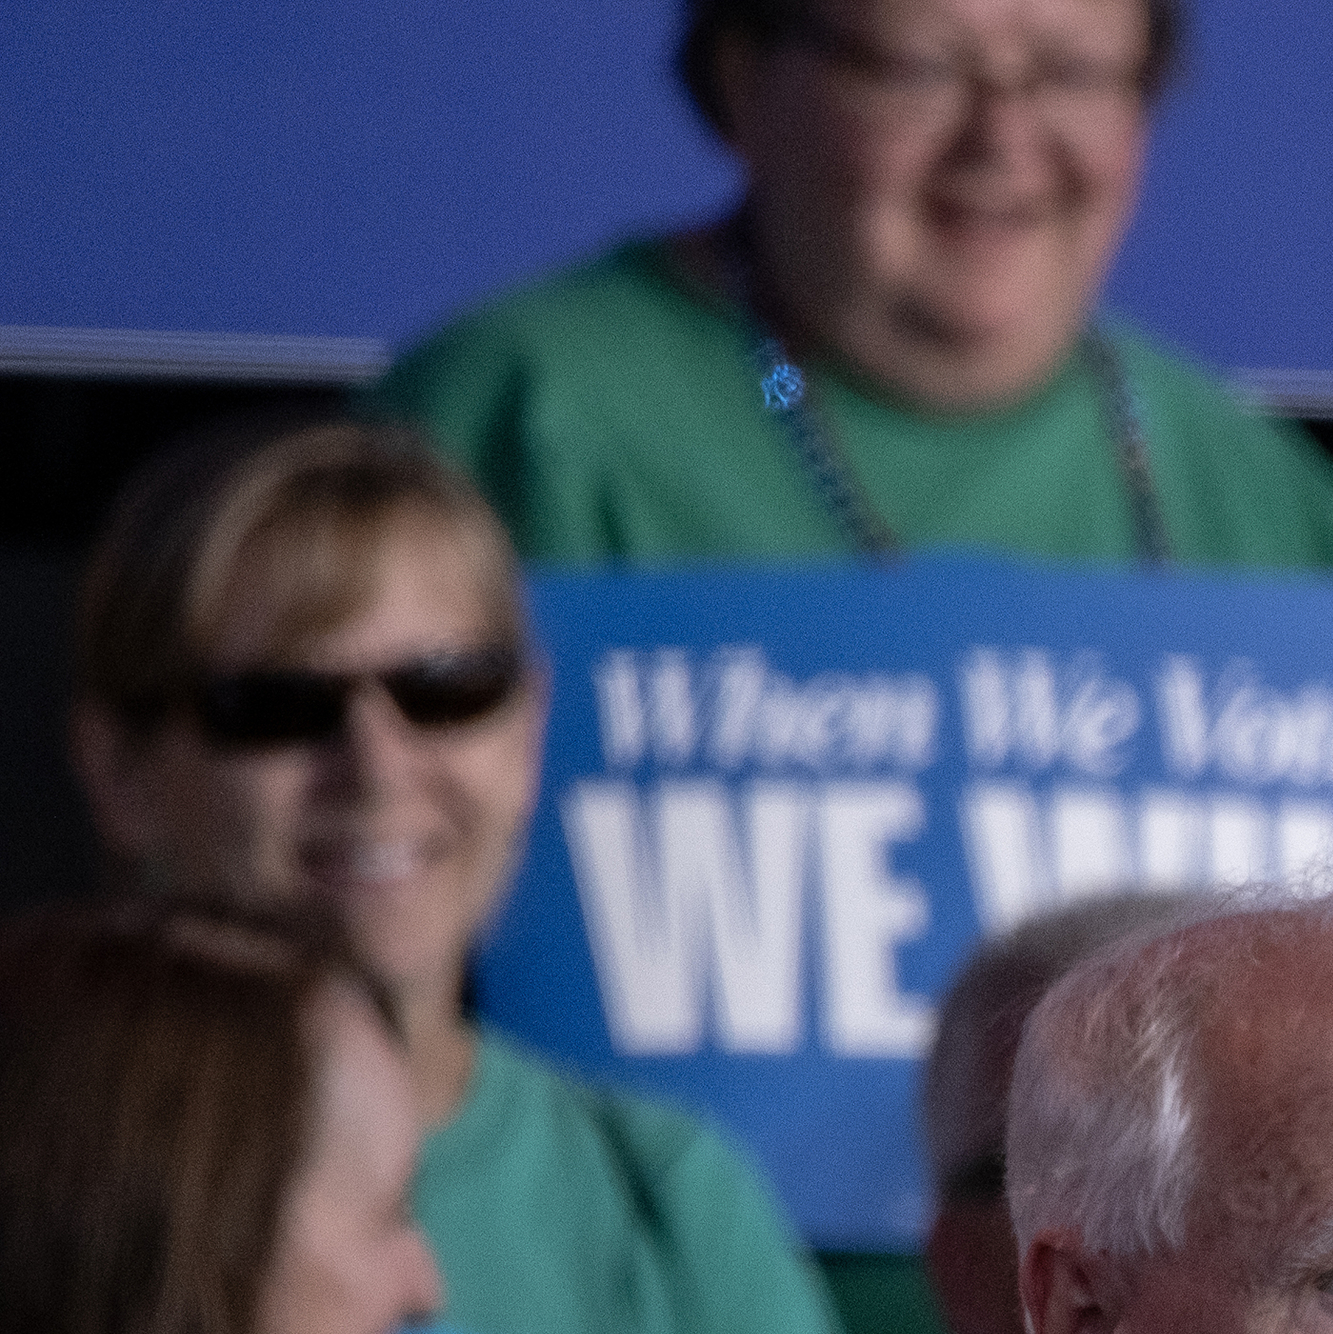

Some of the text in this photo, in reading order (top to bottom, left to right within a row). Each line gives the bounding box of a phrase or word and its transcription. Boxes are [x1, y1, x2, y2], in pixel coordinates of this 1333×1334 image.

[596, 645, 942, 772] When
[955, 646, 1142, 778] We
[566, 783, 940, 1056] WE
